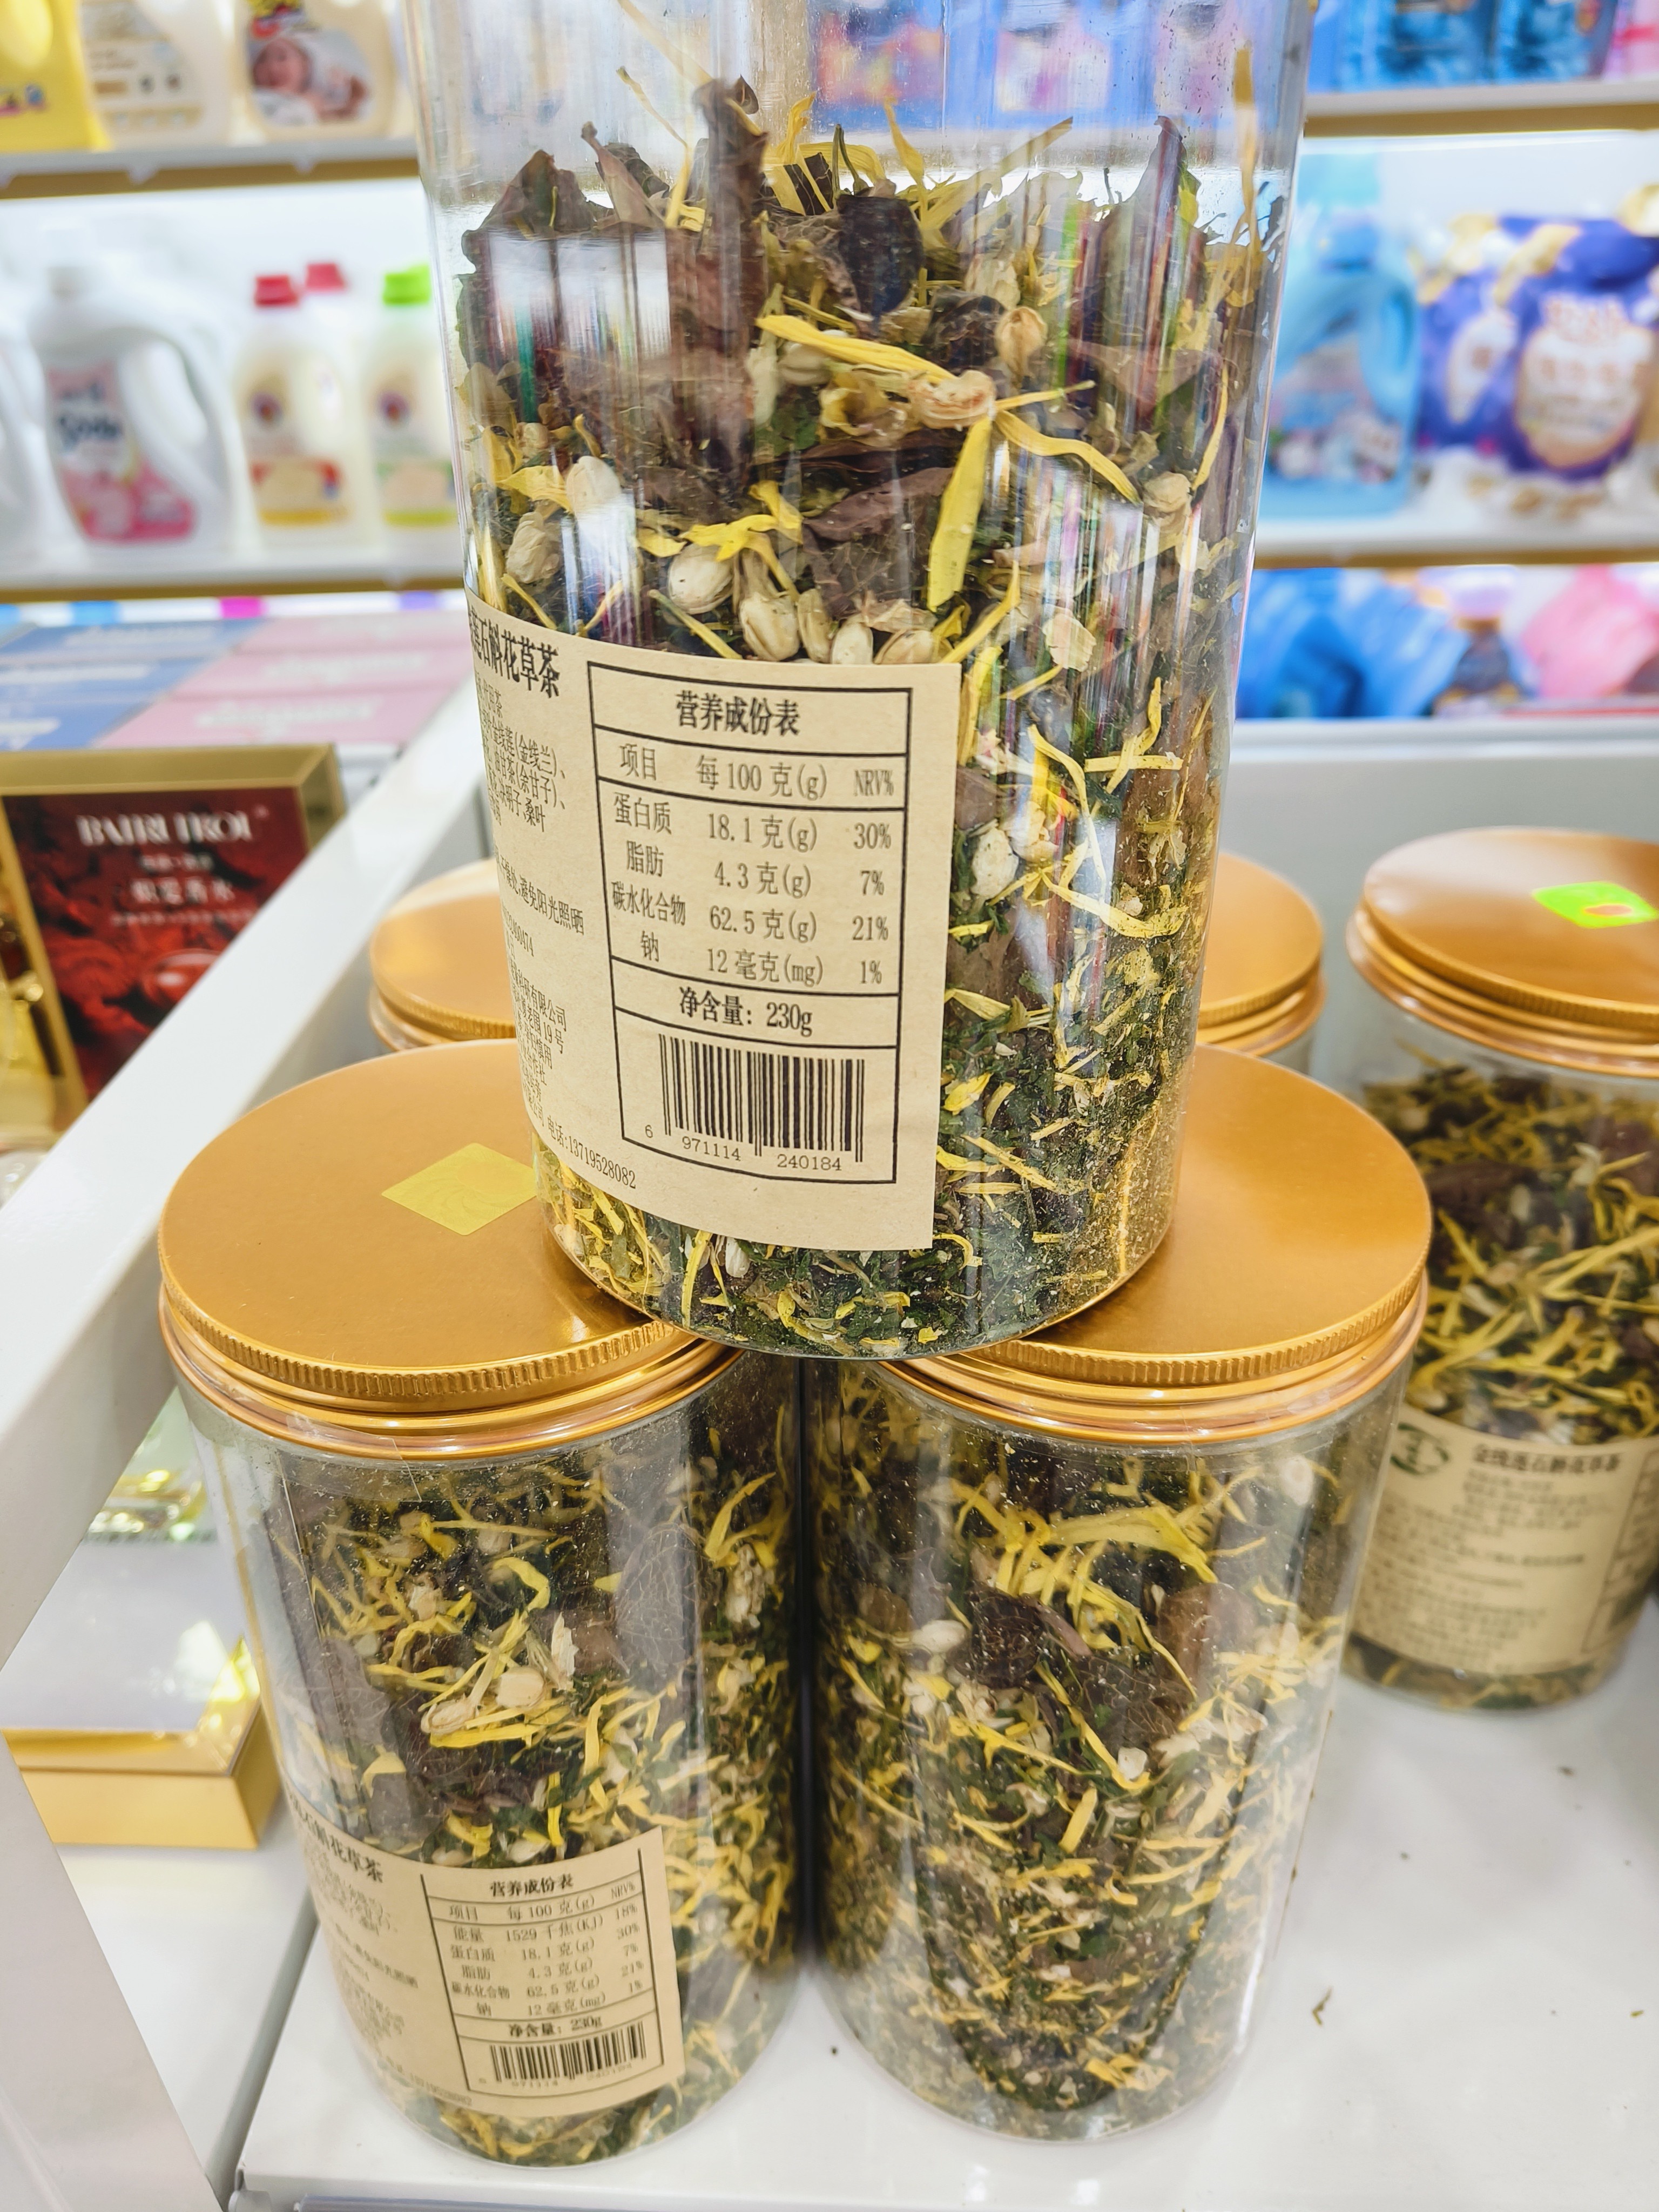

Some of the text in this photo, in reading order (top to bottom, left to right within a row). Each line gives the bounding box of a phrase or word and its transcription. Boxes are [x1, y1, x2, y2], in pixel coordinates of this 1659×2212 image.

[675, 691, 801, 737] 营养成份表
[620, 743, 657, 781] 项目
[854, 770, 894, 798] NRV%
[613, 793, 672, 835] 蛋白质
[853, 823, 892, 849] 30%
[626, 840, 664, 878] 脂肪
[860, 869, 885, 896] 7%
[611, 880, 686, 927] 碳水化合物
[852, 915, 889, 941] 21%
[640, 930, 660, 963] 钠
[860, 960, 882, 985] 1%
[543, 1021, 552, 1043] 19
[554, 1028, 564, 1054] 号
[645, 1125, 842, 1171] 6 971114 240184
[490, 1873, 574, 1897] 营养成份表
[449, 1905, 478, 1921] 项目
[453, 1926, 484, 1943] 能量
[505, 1928, 538, 1943] 1529
[615, 1903, 638, 1920] 18%
[450, 1944, 496, 1962] 蛋白质
[616, 1923, 640, 1940] 30%
[462, 1964, 491, 1981] 脂肪
[623, 1943, 639, 1957] 7%
